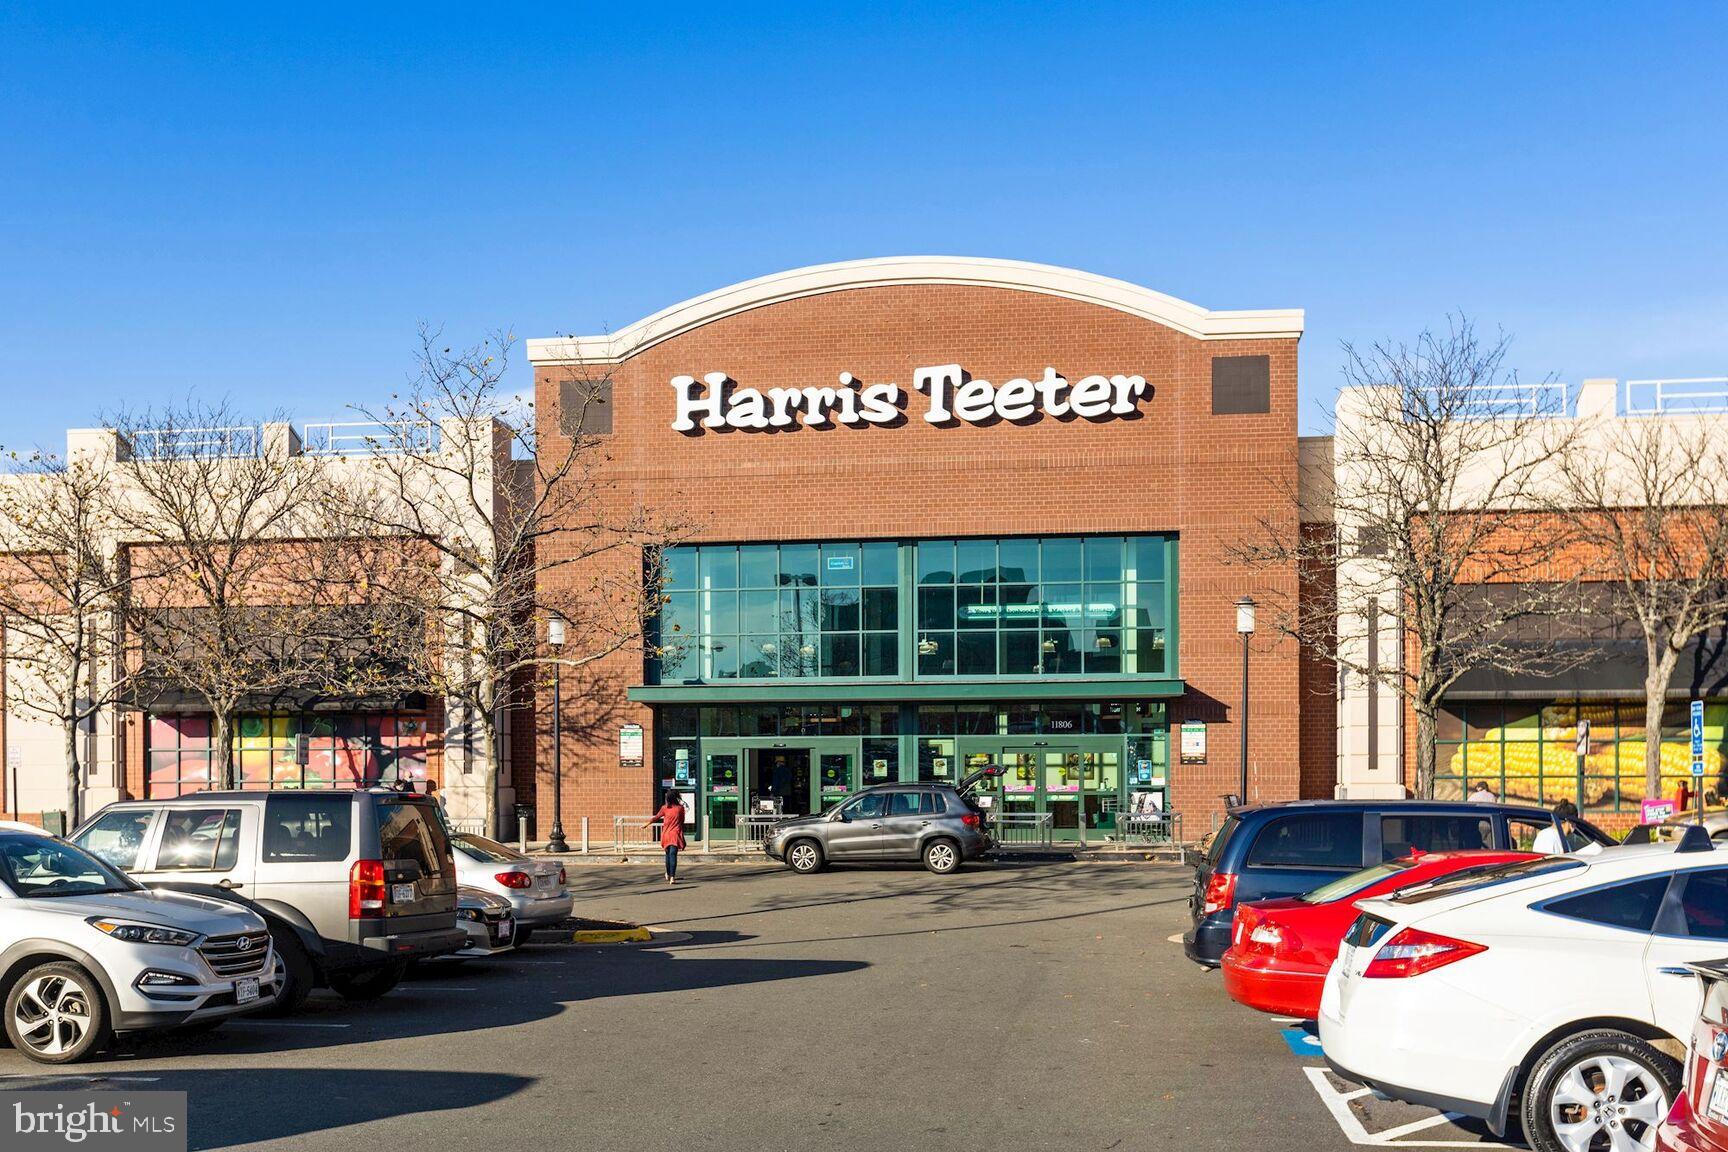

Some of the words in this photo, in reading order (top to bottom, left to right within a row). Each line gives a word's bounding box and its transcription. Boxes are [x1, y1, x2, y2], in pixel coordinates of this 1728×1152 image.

[671, 371, 899, 431] Harris
[913, 363, 1147, 423] Teeter
[1051, 720, 1073, 729] 11806
